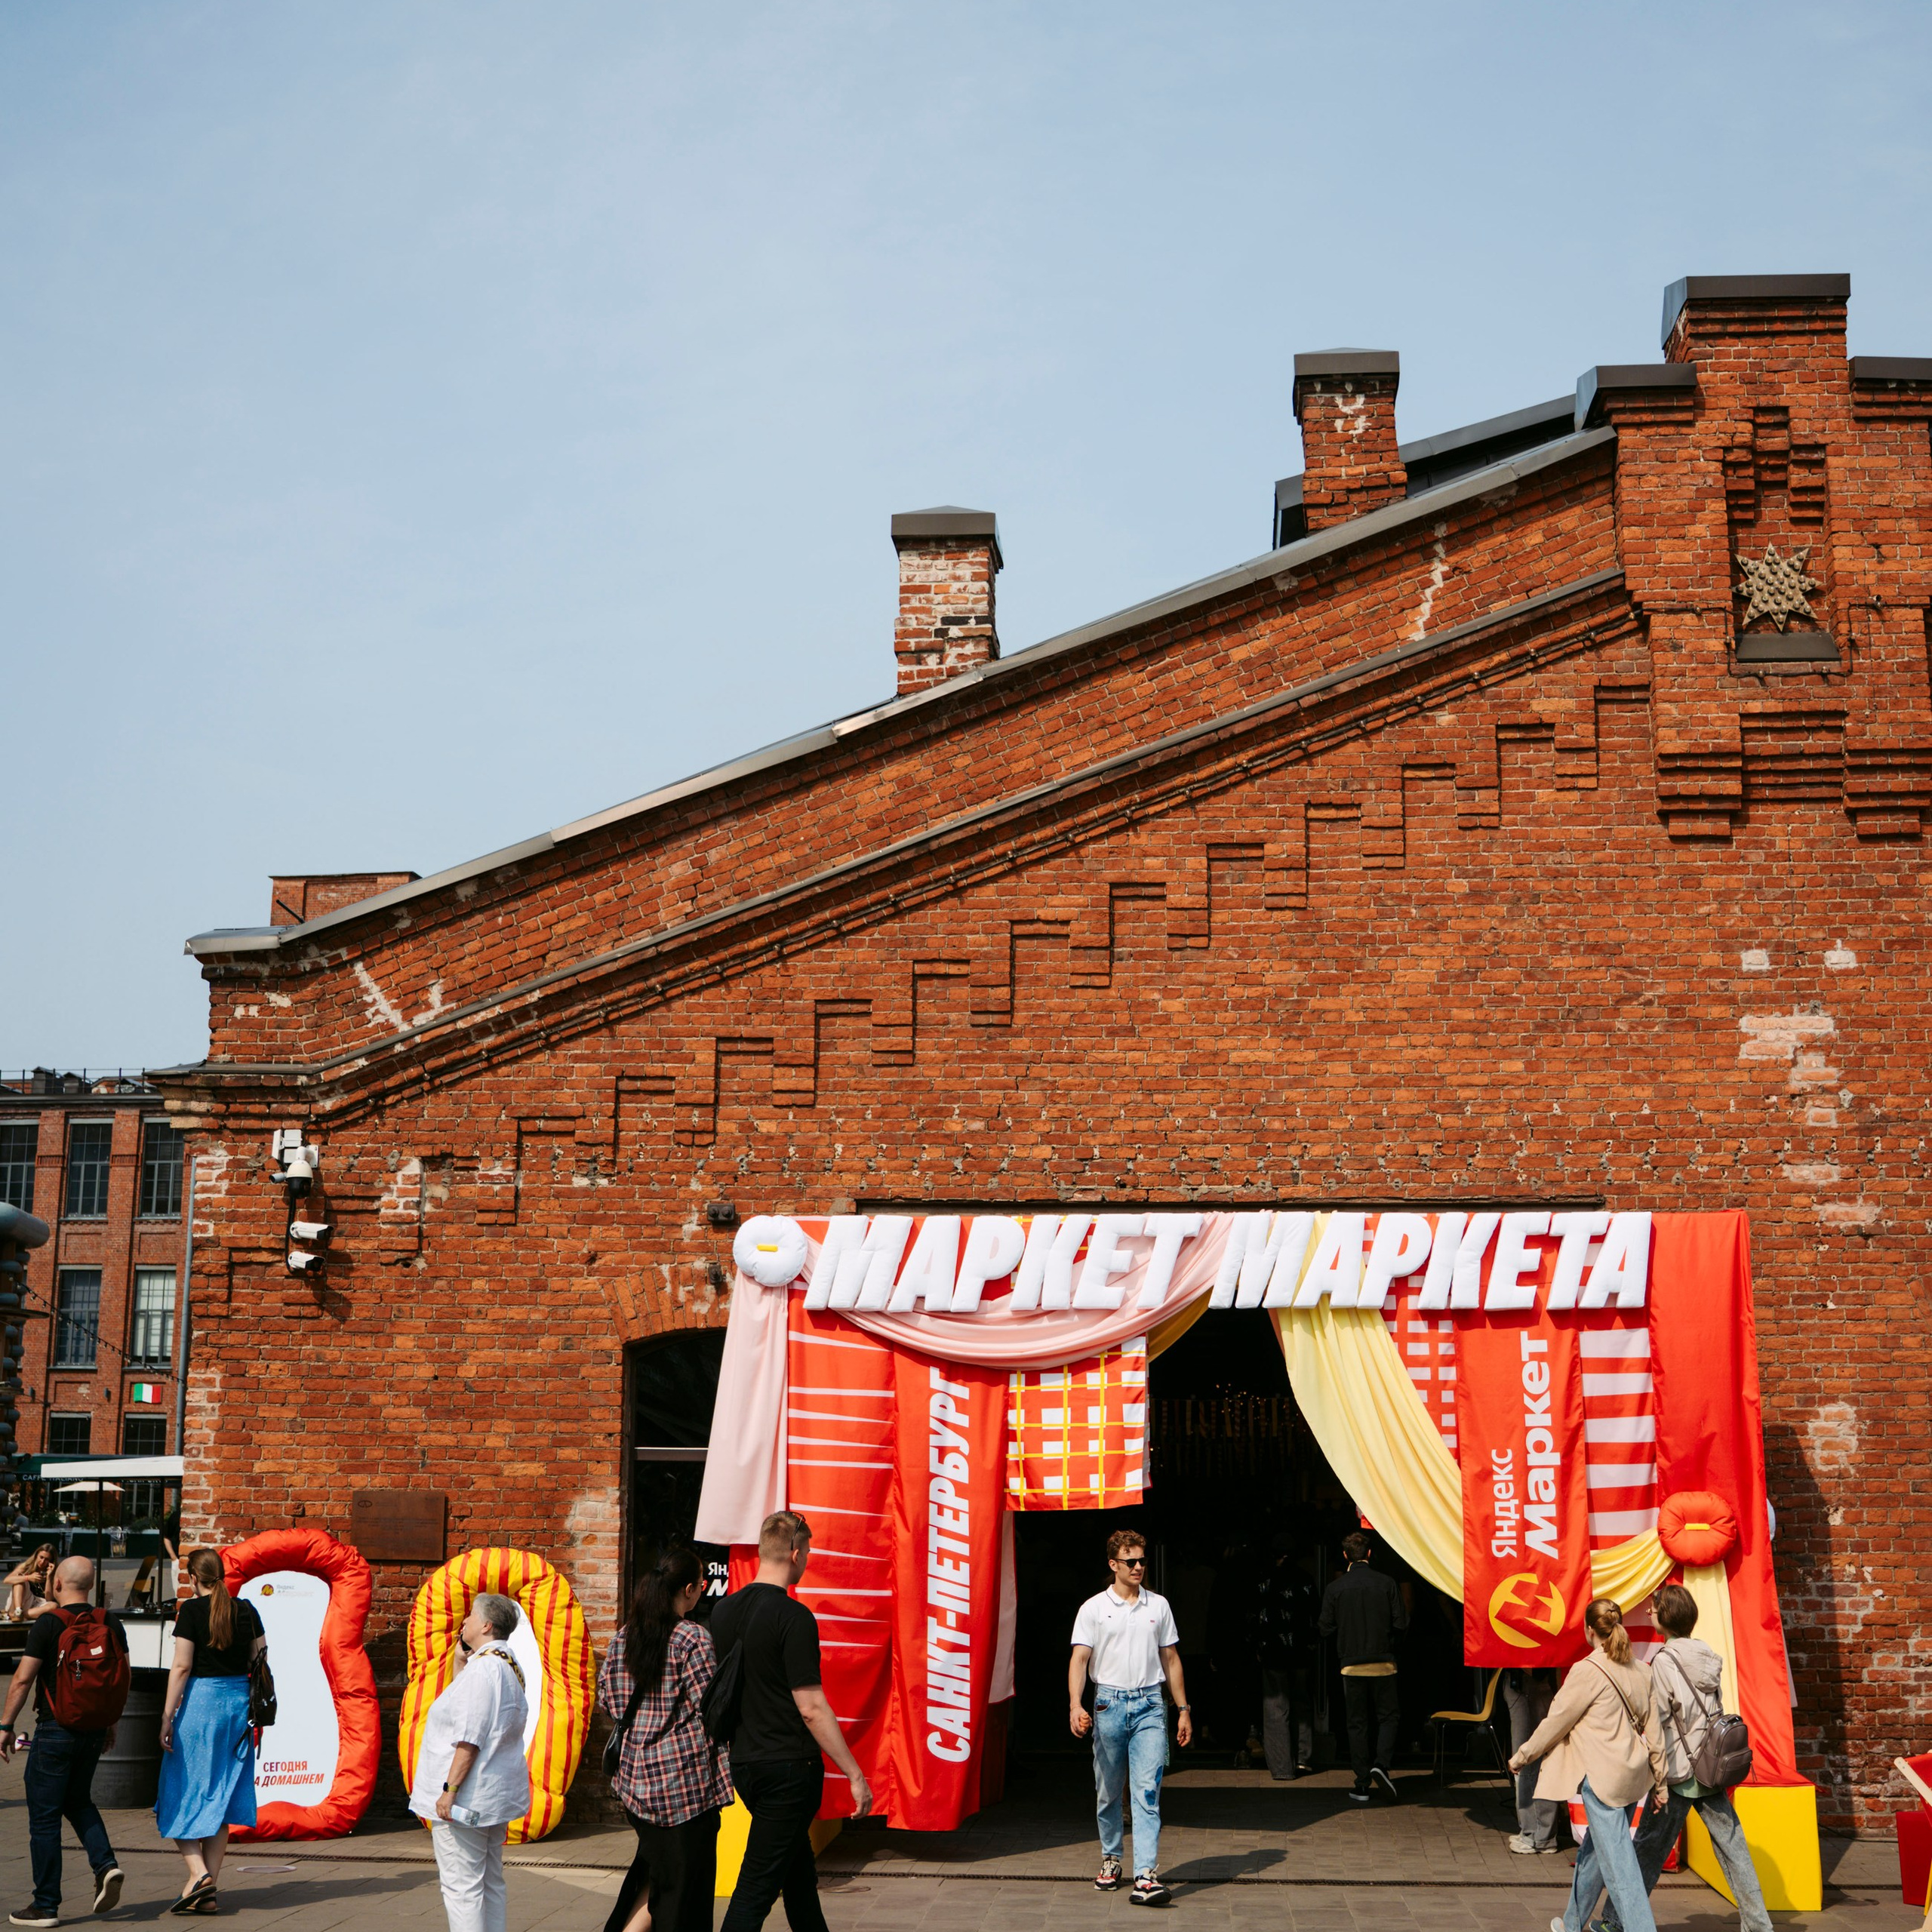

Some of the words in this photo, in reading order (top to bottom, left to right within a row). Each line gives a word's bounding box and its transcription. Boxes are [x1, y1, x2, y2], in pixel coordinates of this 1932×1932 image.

[802, 1214, 1206, 1313] МАРКЕТ
[1208, 1211, 1653, 1311] МАРКЕТА
[1520, 1331, 1561, 1560] Маркет
[1491, 1448, 1519, 1558] Яндекс
[707, 1562, 729, 1577] Ян
[927, 1366, 971, 1763] САНКТ-ПЕТЕРБУРГ
[261, 1774, 325, 1788] ДОМАШНЕМ
[263, 1761, 308, 1773] СЕГОДНЯ
